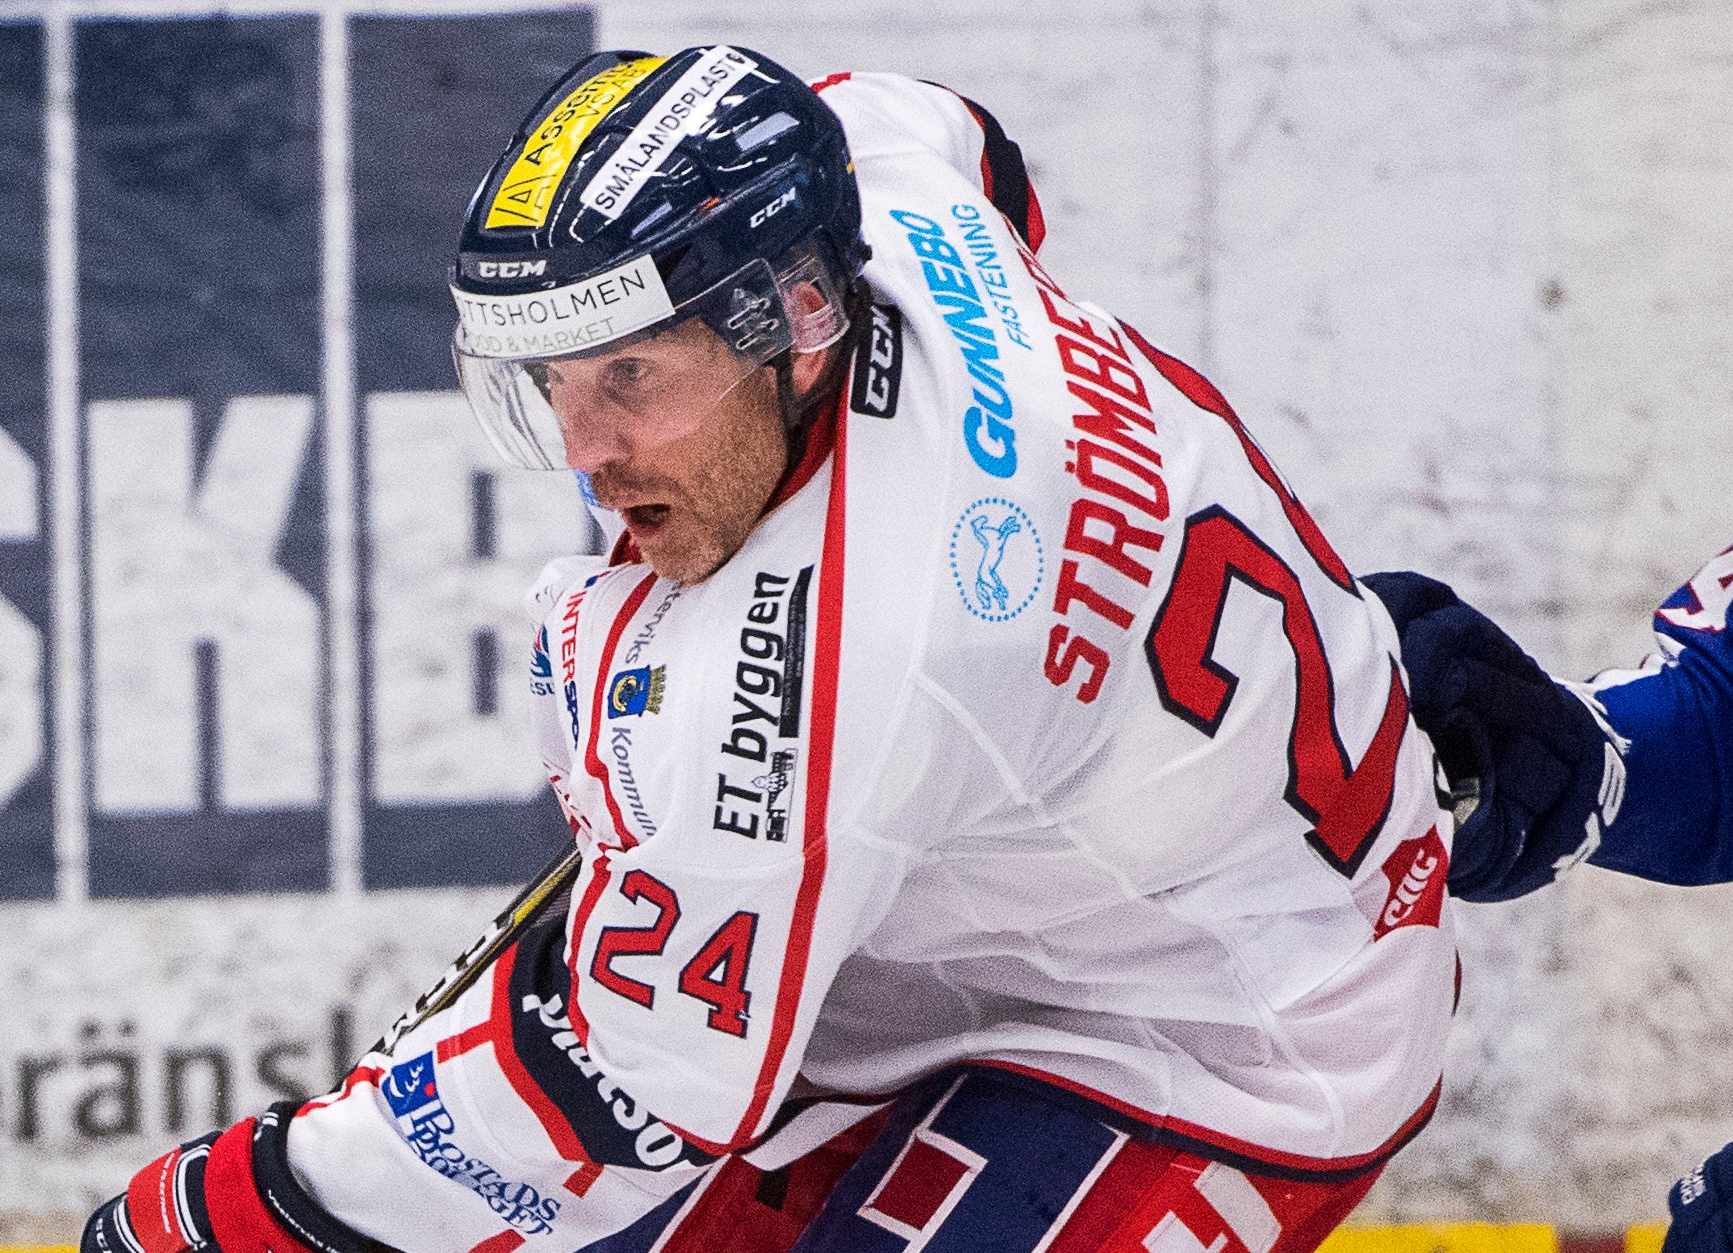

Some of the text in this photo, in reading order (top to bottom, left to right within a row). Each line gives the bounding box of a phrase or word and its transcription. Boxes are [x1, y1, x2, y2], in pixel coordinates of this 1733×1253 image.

[478, 260, 547, 278] CCM
[749, 187, 797, 229] CCM
[523, 316, 616, 352] MARKET
[950, 203, 1034, 352] FASTENING
[866, 304, 894, 412] CCM
[889, 209, 1018, 480] GUNNEBO
[713, 571, 791, 840] ET byggen
[590, 868, 760, 1038] 24
